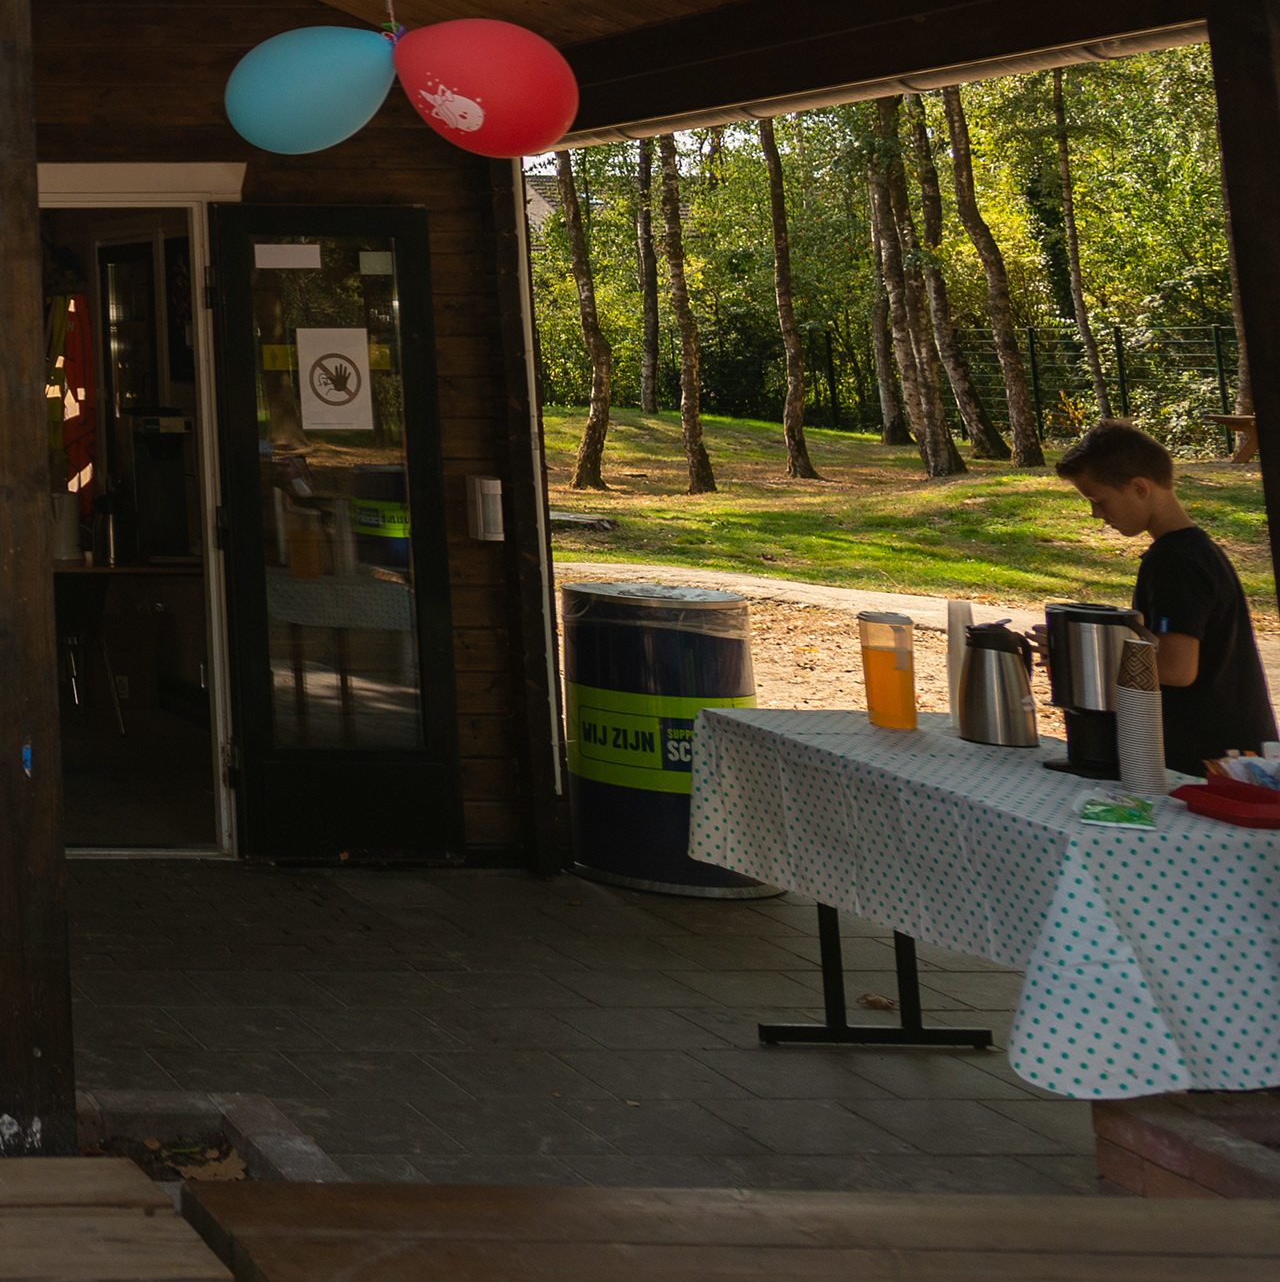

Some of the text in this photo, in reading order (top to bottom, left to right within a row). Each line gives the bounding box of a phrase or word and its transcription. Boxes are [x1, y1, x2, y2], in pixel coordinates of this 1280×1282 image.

[582, 721, 655, 753] WIJ ZIJN
[667, 728, 694, 740] SUPP
[667, 741, 694, 762] SC
